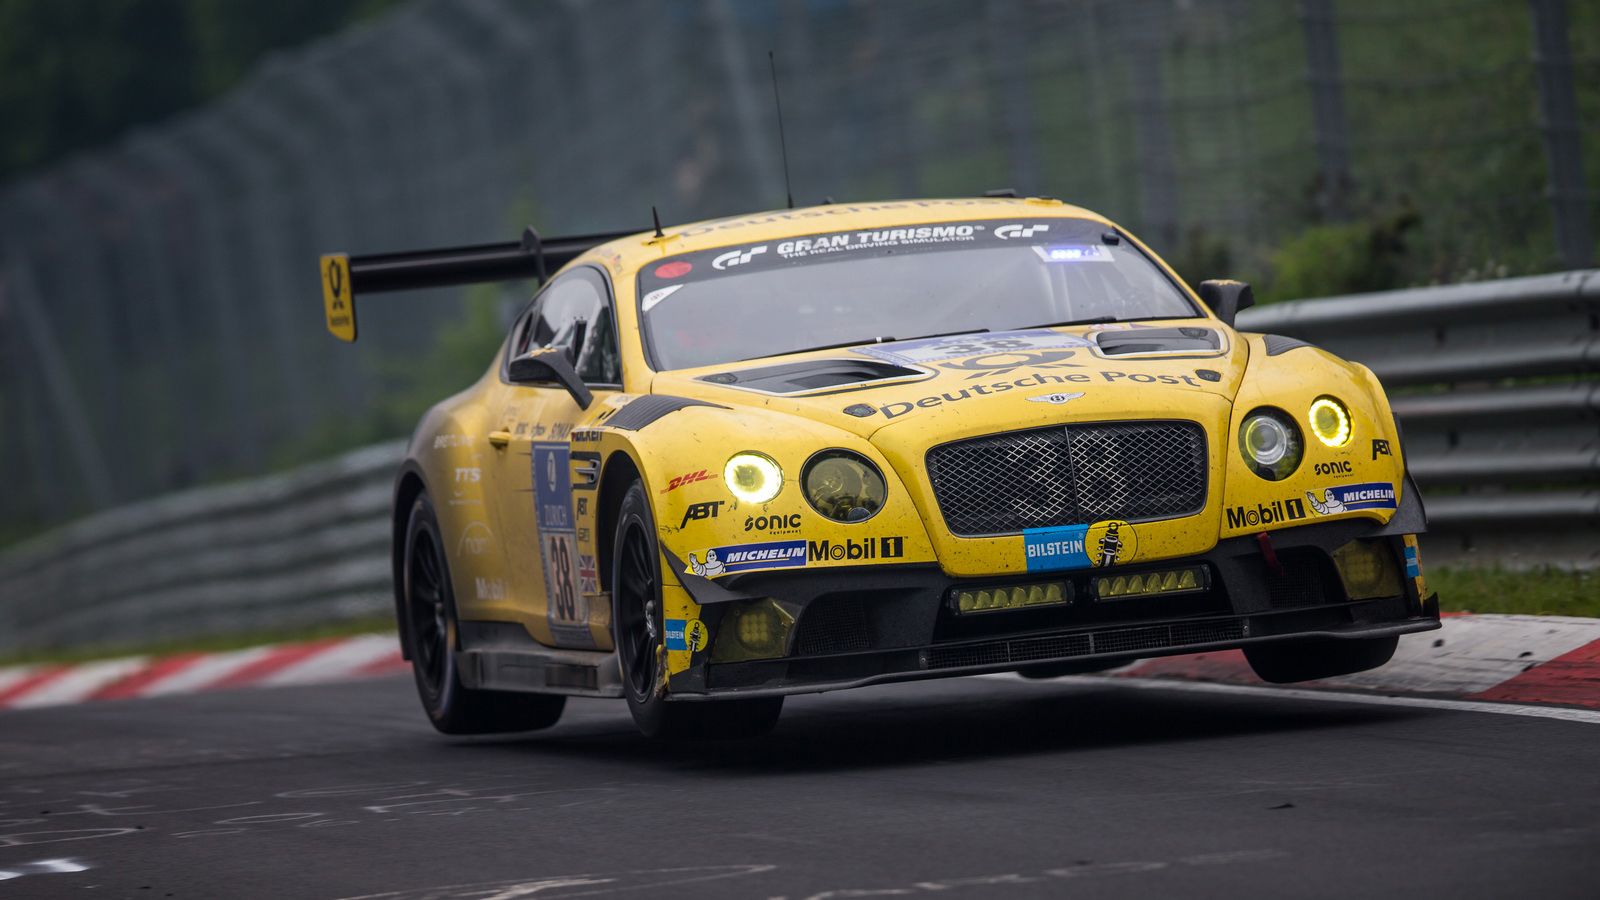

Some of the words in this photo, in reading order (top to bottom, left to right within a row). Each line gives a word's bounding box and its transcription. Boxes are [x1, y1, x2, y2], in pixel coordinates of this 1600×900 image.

[776, 234, 849, 255] GRAN
[845, 240, 898, 251] DRIVING
[901, 235, 976, 246] SIMULATOR
[932, 338, 1034, 355] 38
[879, 373, 1091, 420] Deutsche
[1098, 371, 1201, 388] Post
[1371, 438, 1393, 461] ABT
[668, 469, 709, 492] DHL
[1343, 489, 1395, 503] MICHELIN
[679, 500, 725, 530] ABT
[1226, 501, 1285, 529] Mobil
[726, 546, 806, 563] MICHELIN
[808, 537, 876, 562] Mobil
[1027, 540, 1084, 558] BILSTEIN
[551, 535, 576, 621] 38
